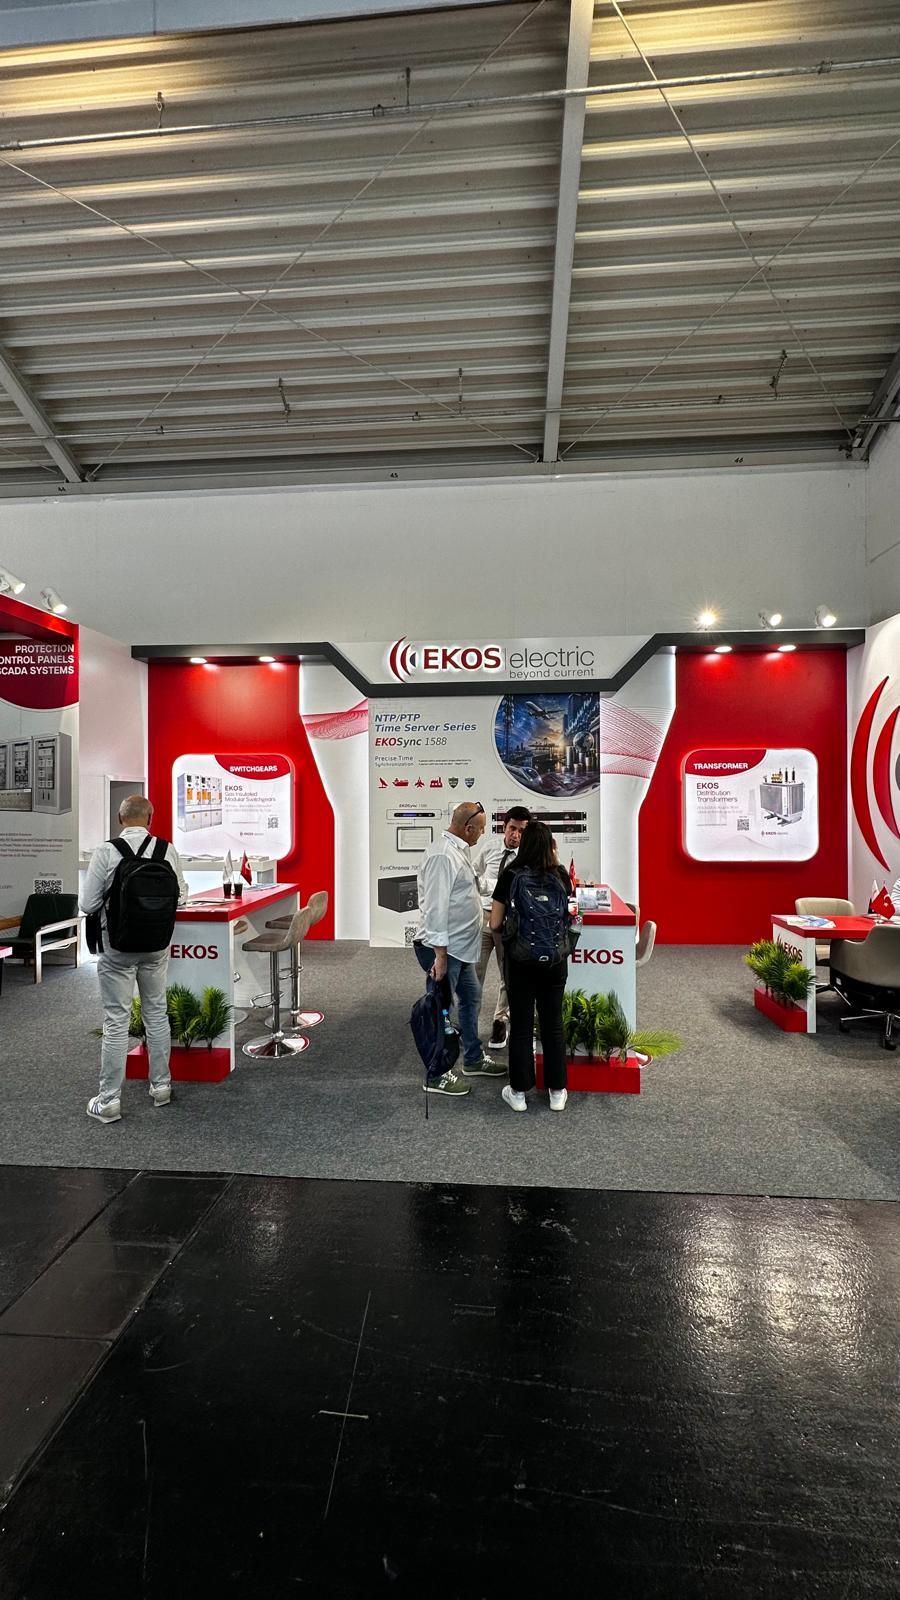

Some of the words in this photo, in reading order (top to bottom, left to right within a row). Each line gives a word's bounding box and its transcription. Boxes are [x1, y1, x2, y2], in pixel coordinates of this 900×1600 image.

[15, 644, 75, 653] PROTECTION
[37, 655, 75, 664] PANELS
[423, 648, 501, 669] EKOS
[509, 646, 595, 668] electric
[0, 666, 28, 675] CADA
[29, 666, 75, 675] SYSTEMS
[509, 669, 550, 680] beyond
[553, 668, 594, 678] current
[375, 713, 421, 722] NTP/PTP
[375, 724, 401, 732] Time
[404, 724, 440, 732] Server
[443, 722, 477, 731] Series
[375, 737, 422, 748] EKOSync
[424, 737, 447, 746] 1588
[693, 762, 749, 770] TRANSFORMER
[170, 944, 219, 960] EKOS
[571, 948, 624, 965] EKOS
